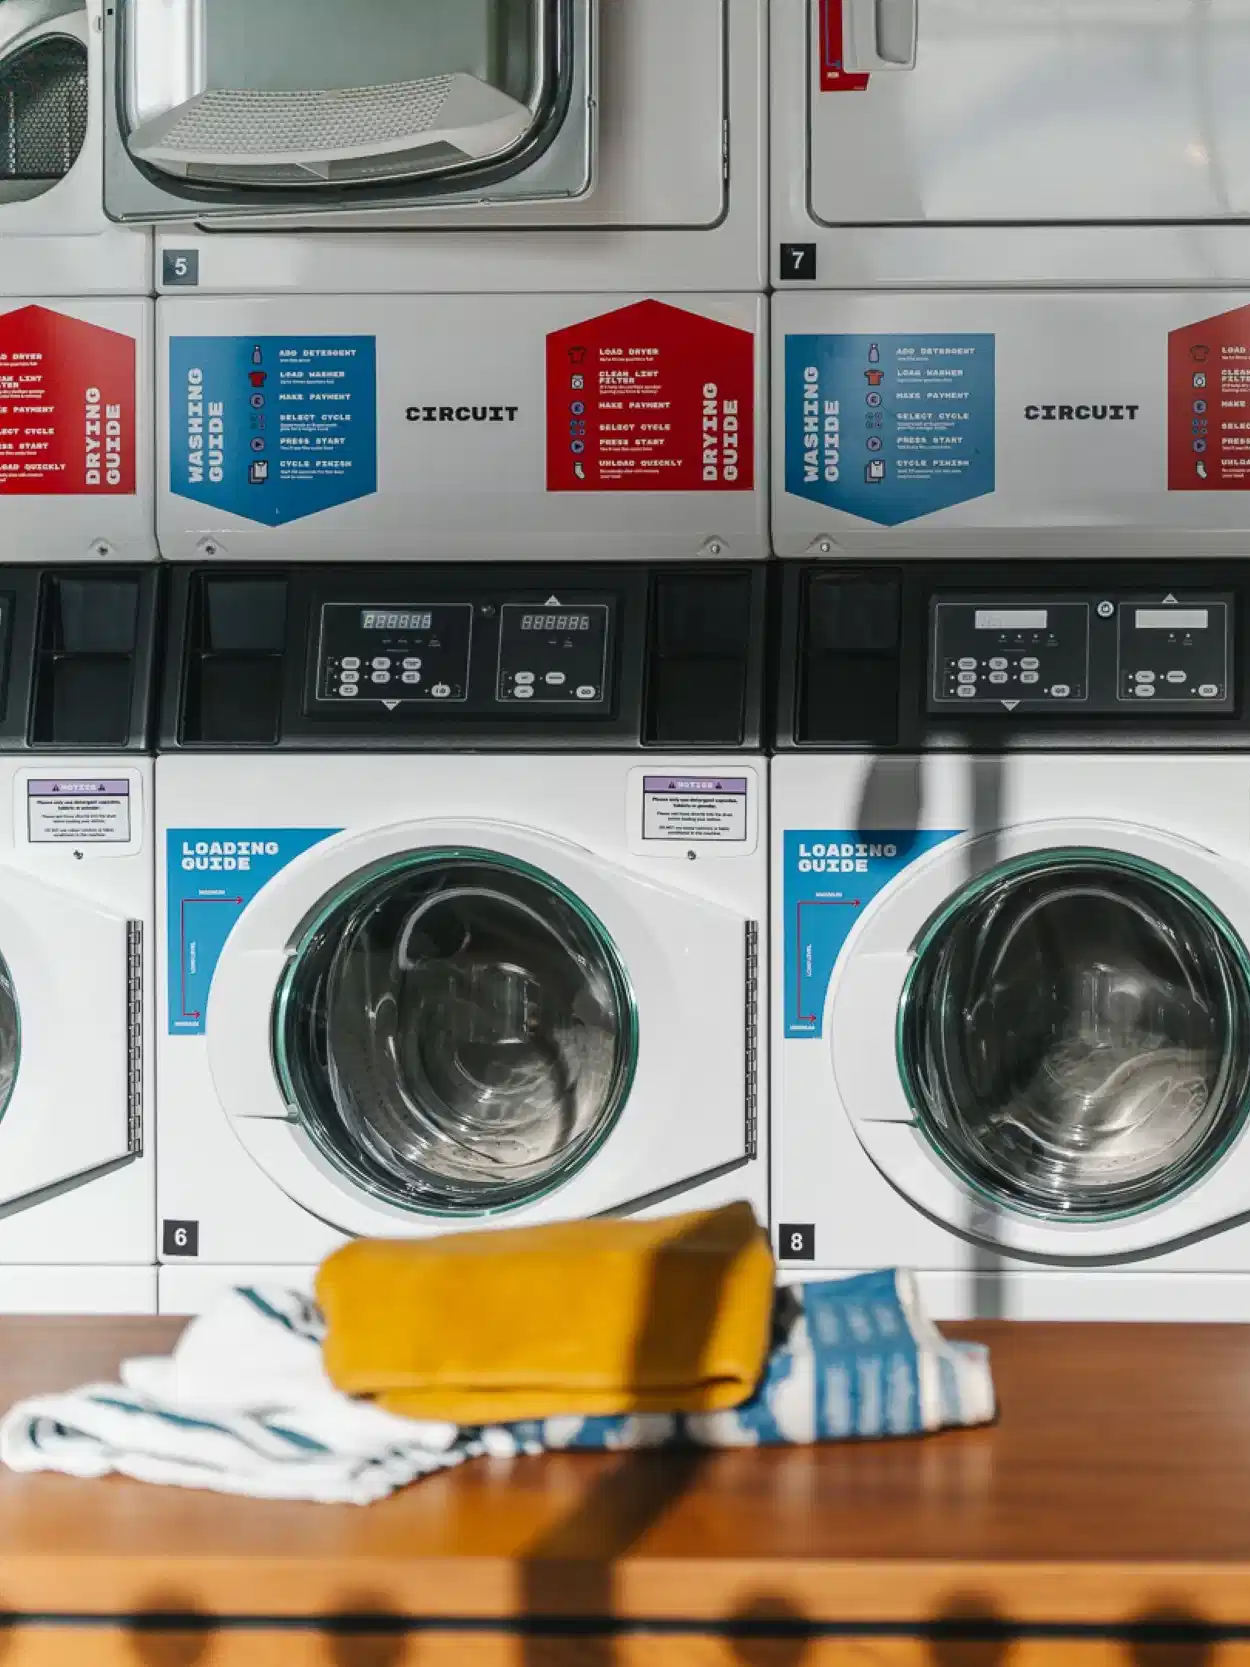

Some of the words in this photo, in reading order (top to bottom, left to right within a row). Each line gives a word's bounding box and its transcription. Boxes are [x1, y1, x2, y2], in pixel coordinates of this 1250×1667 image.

[174, 258, 187, 276] 5
[792, 251, 804, 270] 7
[406, 407, 518, 421] CIRCUIT
[1025, 405, 1139, 420] CIRCUIT
[188, 368, 203, 483] WASHING
[703, 383, 717, 481] DRYING
[804, 366, 819, 482] WASHING
[86, 387, 100, 484] DRYING
[106, 404, 120, 484] GUIDE
[208, 401, 224, 482] GUIDE
[723, 400, 738, 481] GUIDE
[824, 400, 839, 482] GUIDE
[182, 842, 279, 855] LOADING
[798, 844, 897, 857] LOADING
[182, 857, 251, 870] GUIDE
[798, 859, 868, 872] GUIDE
[175, 1227, 187, 1246] 6
[790, 1232, 803, 1251] 8
